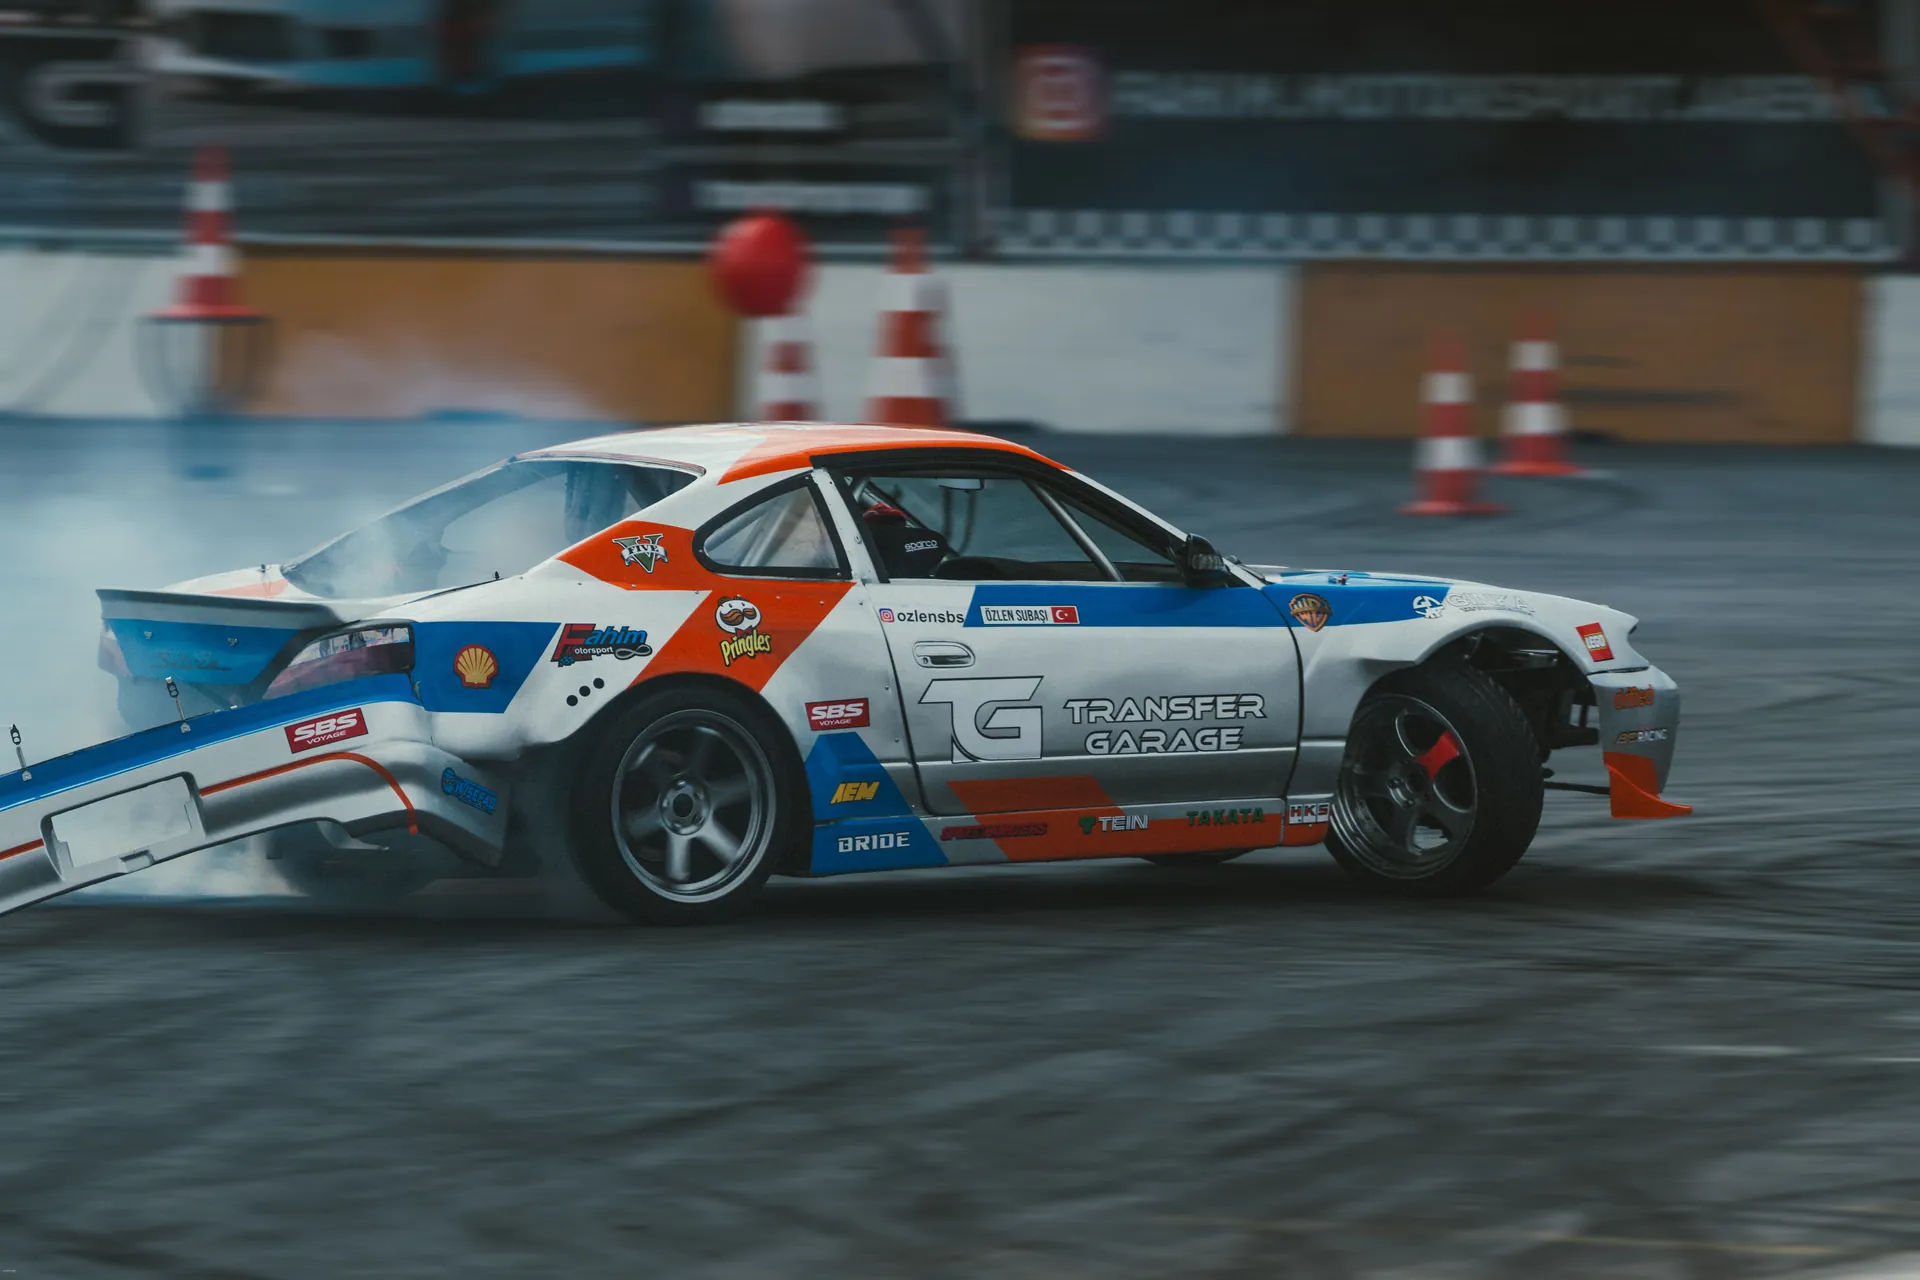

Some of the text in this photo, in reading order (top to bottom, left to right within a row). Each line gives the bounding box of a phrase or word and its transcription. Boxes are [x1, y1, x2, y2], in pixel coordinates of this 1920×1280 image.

[628, 544, 660, 554] FIVE
[904, 540, 937, 551] sparco
[897, 609, 965, 623] ozlensbs
[985, 607, 1049, 624] ÖZLEN SUBAŞI
[551, 623, 648, 661] Fahim
[720, 628, 771, 667] Pringles
[811, 702, 864, 720] SBS
[1063, 693, 1267, 724] TRANSFER
[294, 713, 358, 742] SBS
[819, 718, 852, 727] VOYAGE
[306, 730, 347, 745] VOYAGE
[1085, 726, 1244, 755] GARAGE
[1186, 807, 1264, 826] TAKATA
[1290, 803, 1329, 817] HKS
[1098, 815, 1149, 832] TEIN
[837, 832, 910, 853] BRIDE
